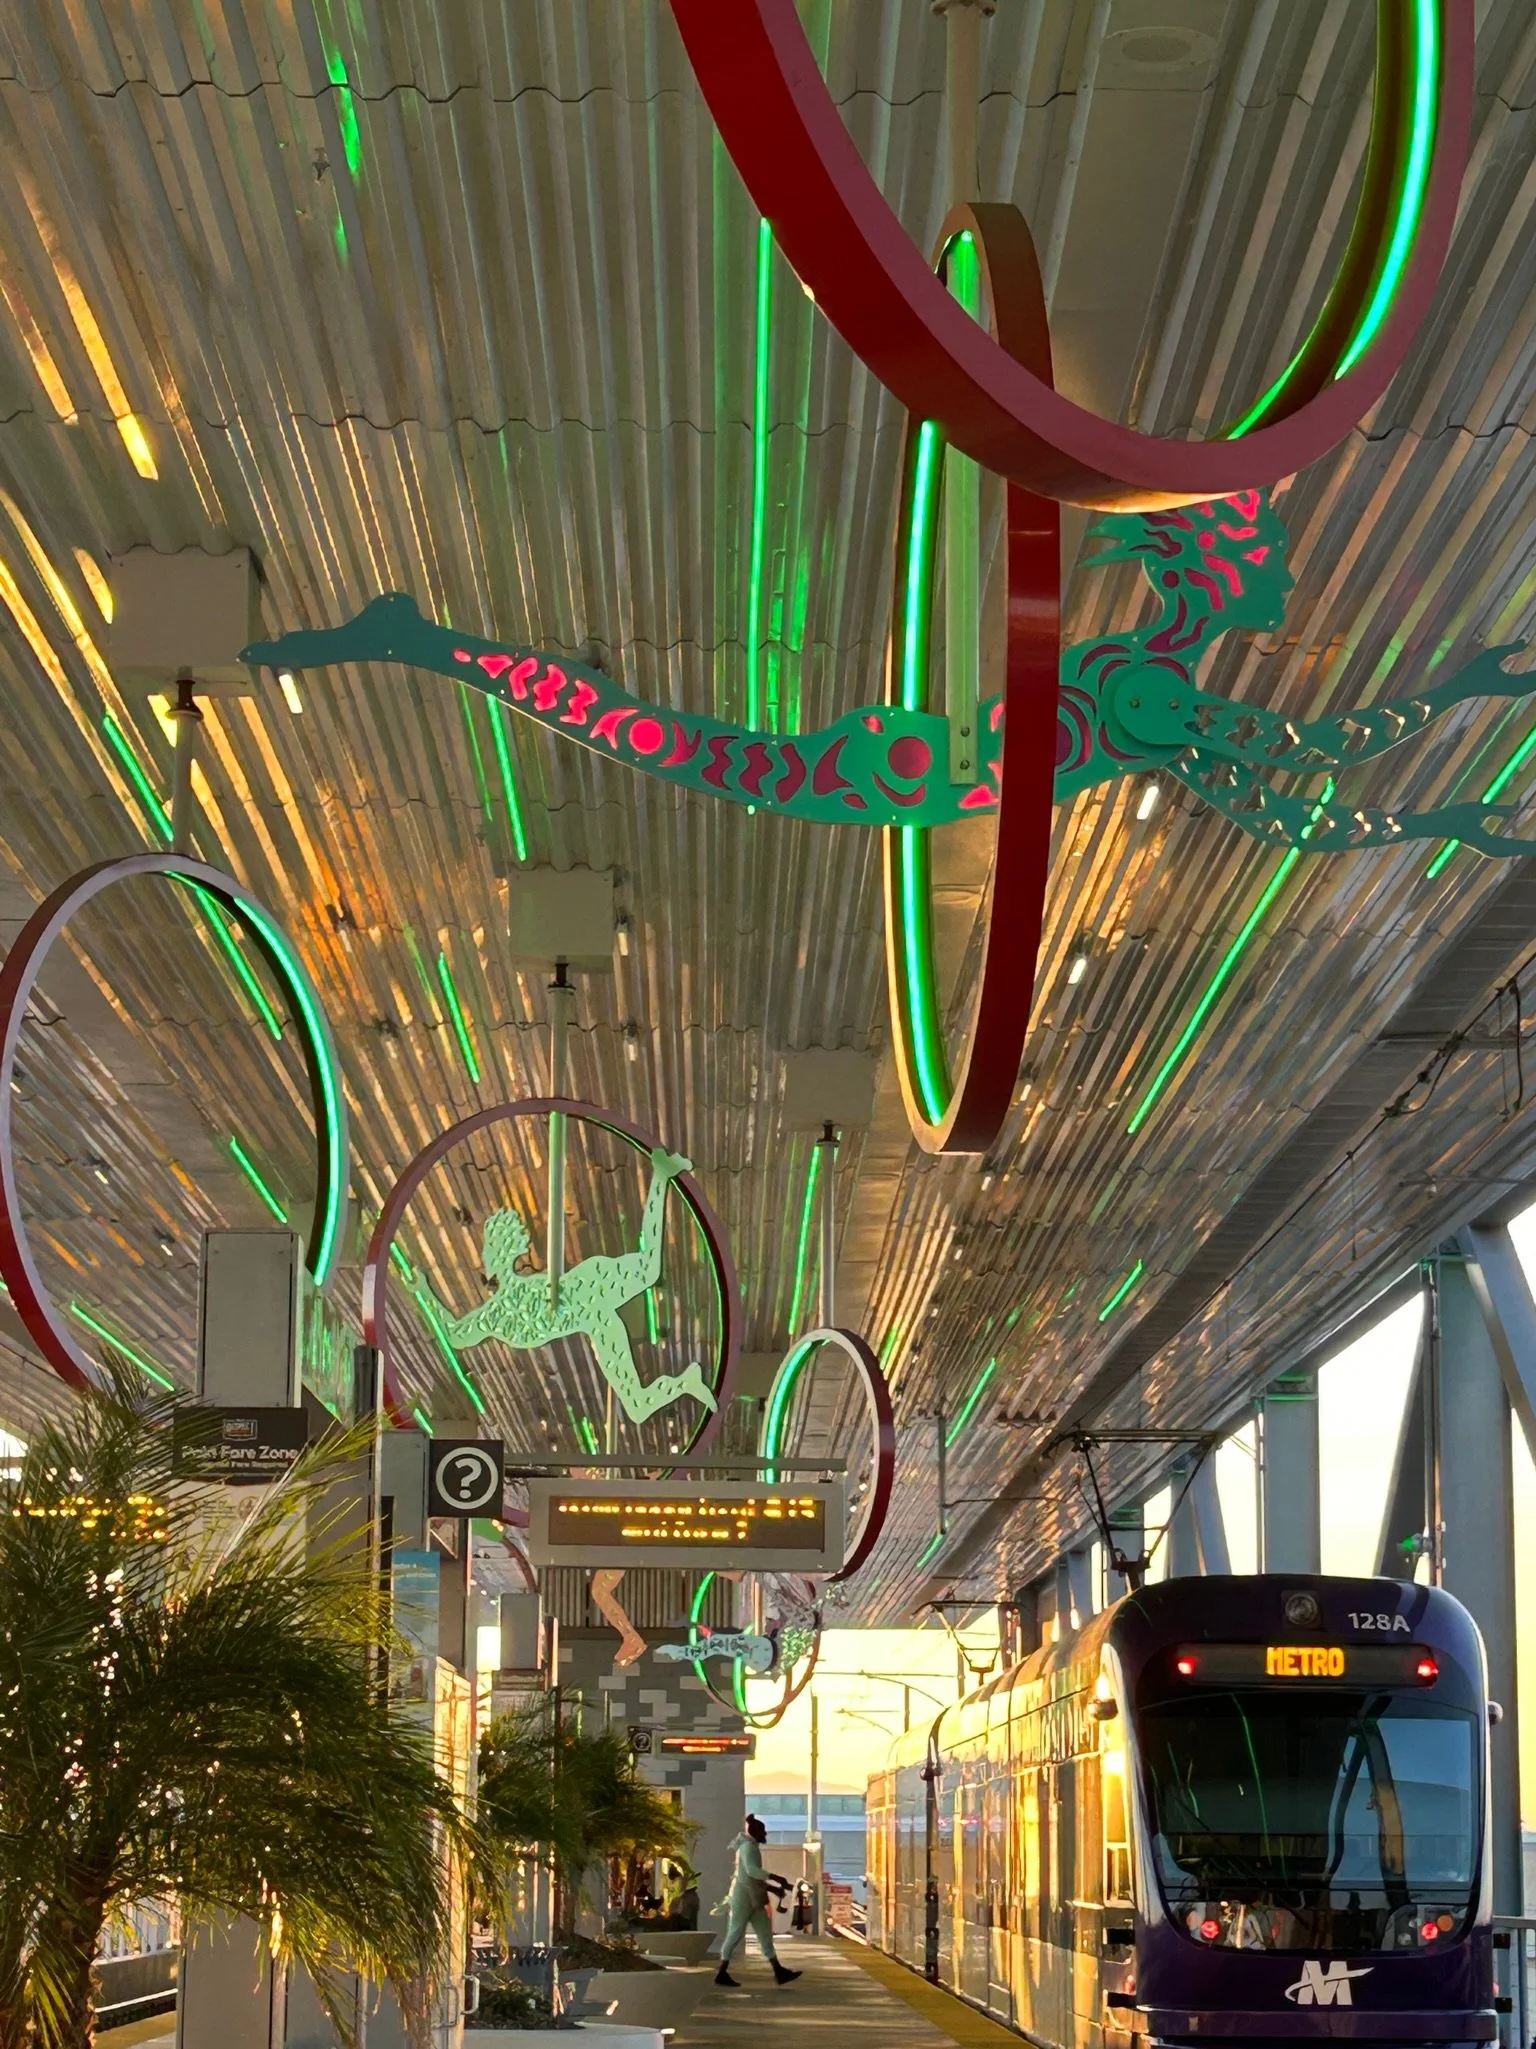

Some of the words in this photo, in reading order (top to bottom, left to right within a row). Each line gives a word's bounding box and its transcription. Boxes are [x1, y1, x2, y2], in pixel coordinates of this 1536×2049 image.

[220, 1445, 256, 1459] Fare
[258, 1445, 299, 1459] Zone
[1348, 1612, 1411, 1633] 128A
[1266, 1646, 1345, 1677] METRO
